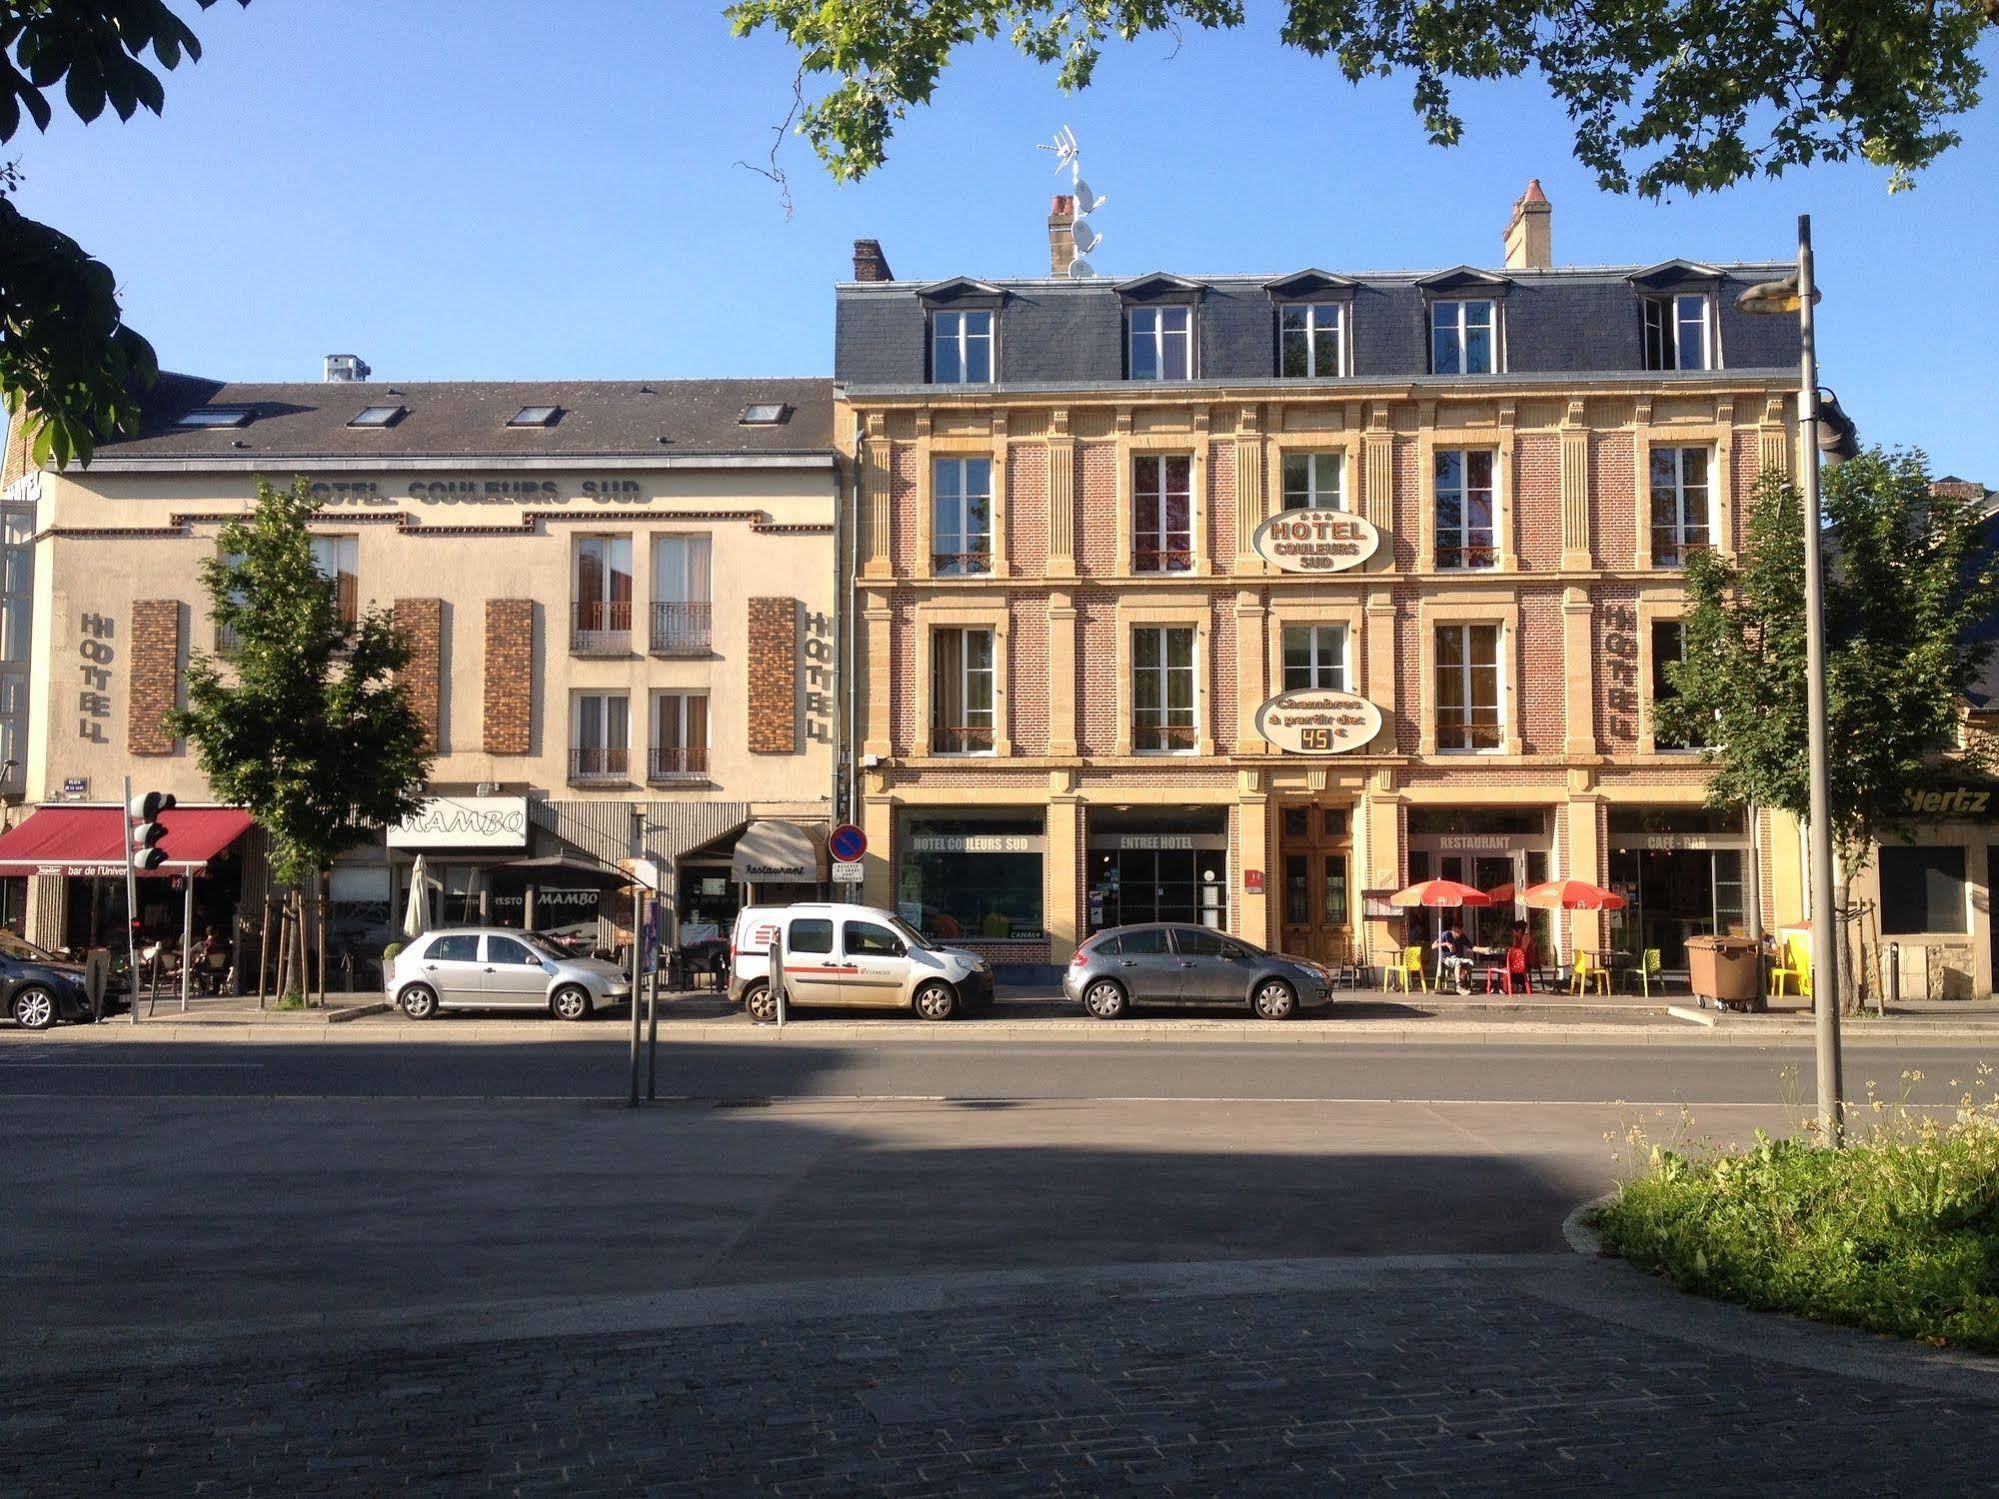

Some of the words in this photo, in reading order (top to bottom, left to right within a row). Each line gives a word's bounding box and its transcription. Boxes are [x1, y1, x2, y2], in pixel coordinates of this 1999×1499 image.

[408, 481, 560, 502] COULEURS
[582, 480, 641, 502] SUD
[1270, 522, 1367, 540] HOTEL
[1274, 543, 1359, 556] COULEURS
[1300, 557, 1333, 569] SUD
[79, 613, 102, 739] HOTEL
[804, 612, 825, 739] HOTEL
[1605, 605, 1627, 737] HOTEL
[1276, 699, 1363, 710] Chambres
[1284, 714, 1334, 728] partir
[1302, 729, 1328, 749] 45
[389, 810, 524, 836] MAMBO
[913, 837, 946, 850] HOTEL
[948, 837, 1002, 850] COULEURS
[1006, 837, 1028, 850] SUD
[1120, 836, 1159, 849] ENTREE
[1160, 836, 1193, 849] HOTEL
[1440, 836, 1511, 849] RESTAURANT
[1647, 833, 1675, 849] CAFÉ
[1683, 836, 1707, 849] BAR
[68, 866, 81, 875] bar
[84, 866, 96, 875] de
[97, 866, 127, 875] l'Univer
[745, 864, 805, 875] Restaurant
[537, 893, 598, 905] MAMBO
